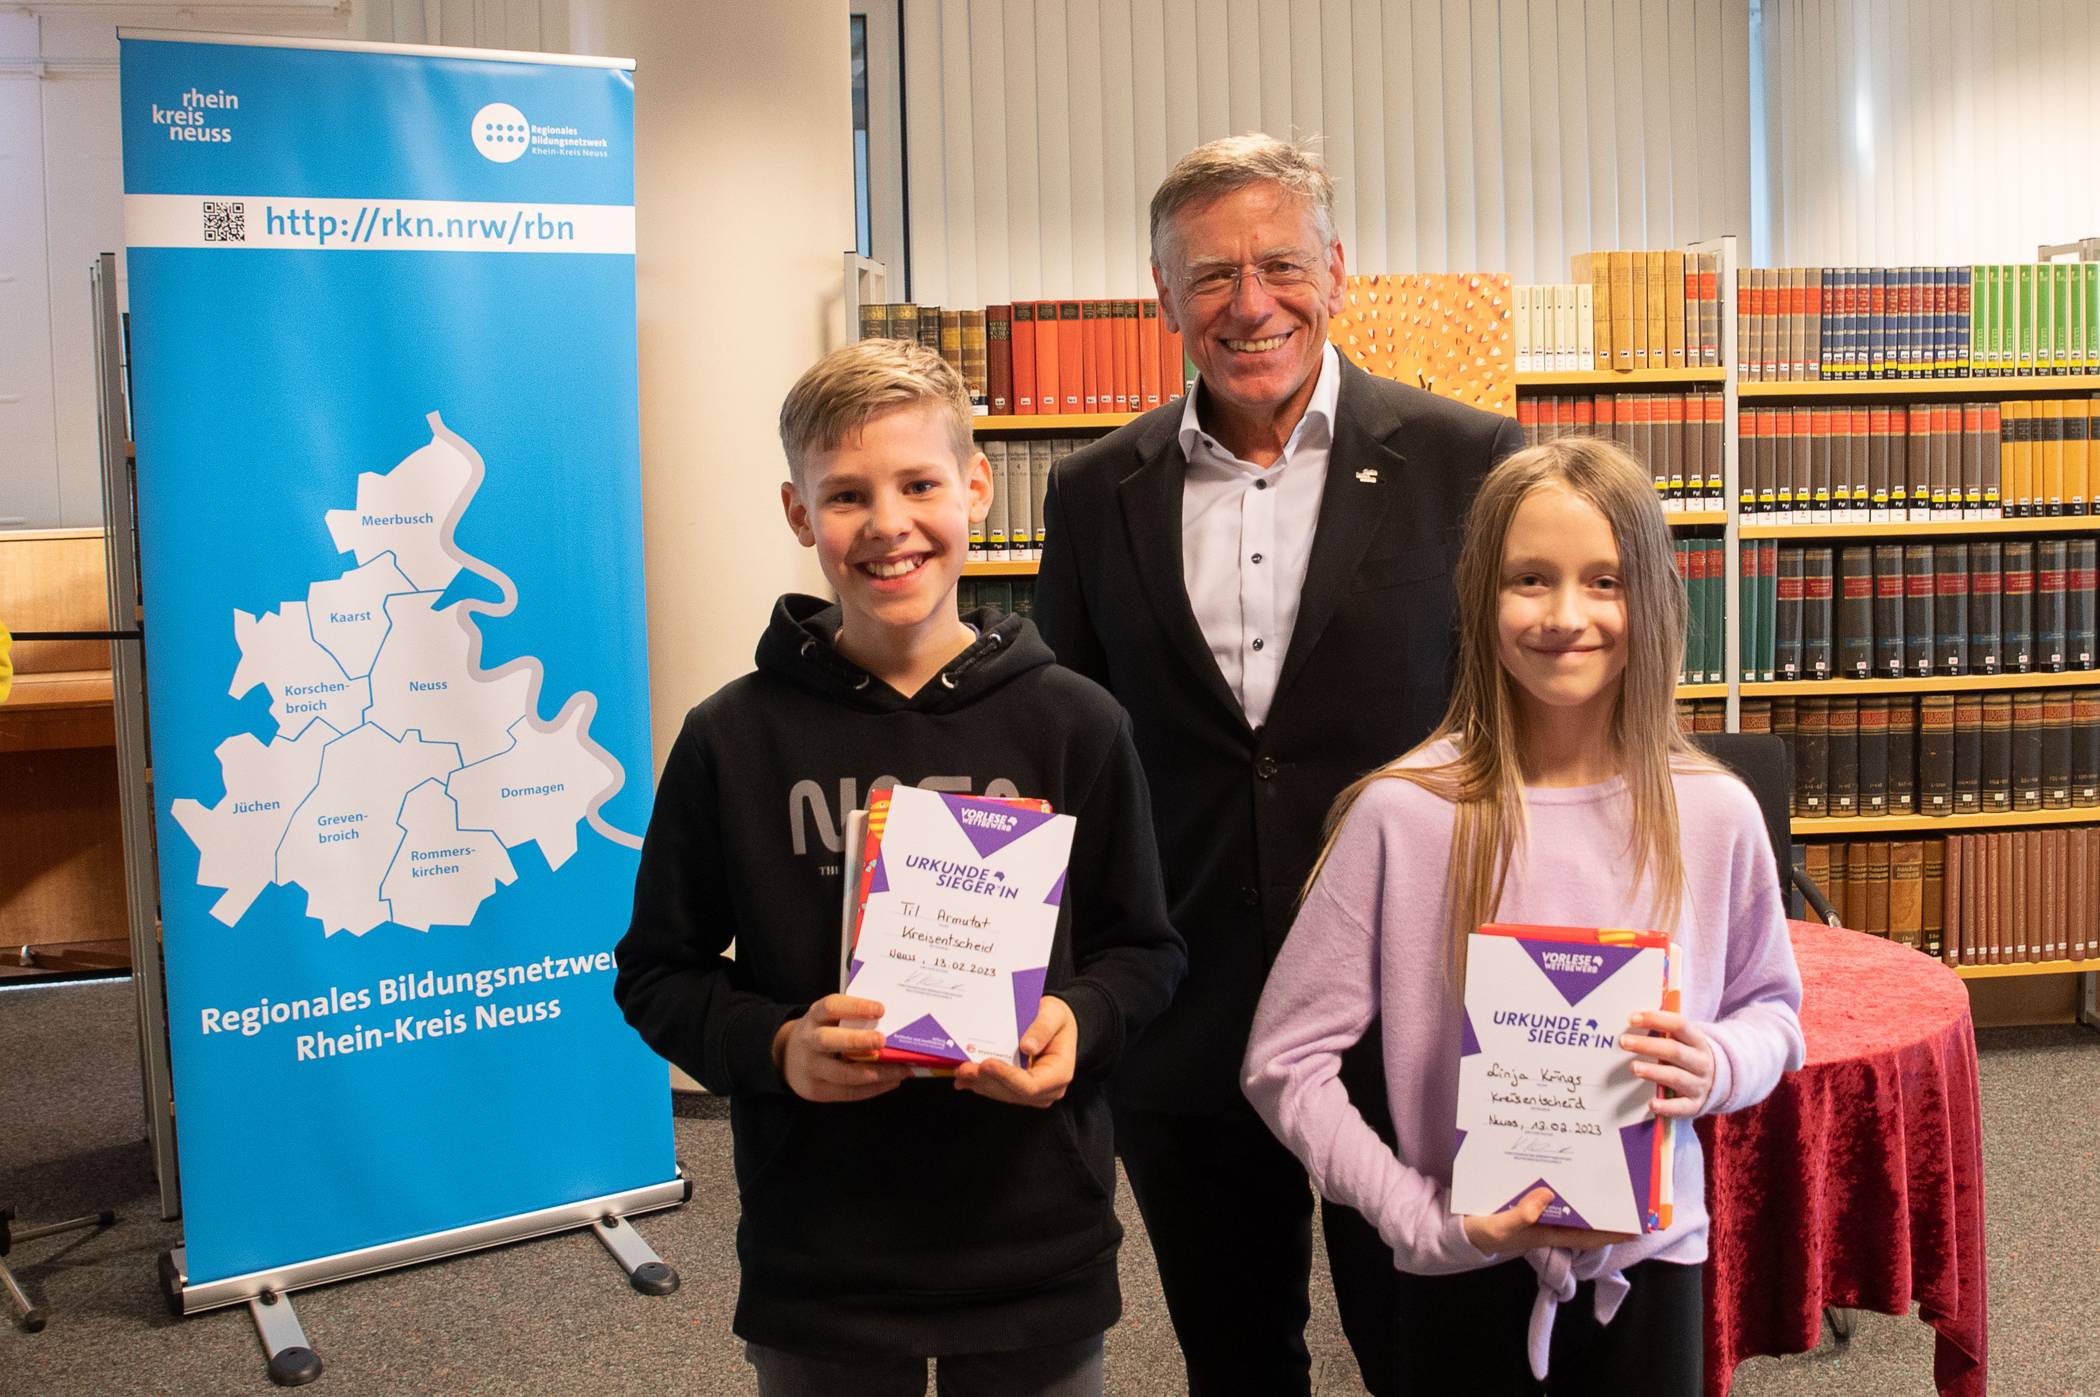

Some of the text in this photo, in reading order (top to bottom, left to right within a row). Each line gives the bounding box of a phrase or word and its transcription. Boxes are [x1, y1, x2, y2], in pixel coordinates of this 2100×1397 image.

[182, 88, 239, 109] rhein
[152, 103, 205, 126] kreis
[169, 126, 232, 143] neuss
[531, 125, 578, 136] Regionales
[531, 135, 608, 147] Bildungsnetzwerk
[531, 147, 608, 158] Rhein-Kreis Neuss
[266, 206, 575, 245] http://rkn.nrw/rbn
[361, 513, 433, 527] Meerbusch
[330, 611, 372, 624] Kaarst
[285, 681, 350, 697] Korschen-
[409, 680, 448, 692] Neuss
[286, 700, 327, 714] broich
[501, 783, 565, 799] Dormagen
[232, 800, 280, 815] Jüchen
[317, 812, 368, 827] Greven-
[961, 808, 1008, 824] VORLESE
[319, 829, 360, 844] broich
[411, 847, 476, 862] Rommers-
[412, 863, 459, 879] kirchen
[905, 855, 990, 881] URKUNDE
[901, 900, 990, 929] Til Armutat
[902, 925, 994, 953] Kreisentscheid
[1542, 951, 1593, 966] VORLESE
[201, 985, 371, 1037] Regionales
[297, 997, 562, 1062] Rhein-Kreis Neuss
[1493, 1011, 1582, 1032] URKUNDE
[1491, 1091, 1586, 1110] Kreisentscheid
